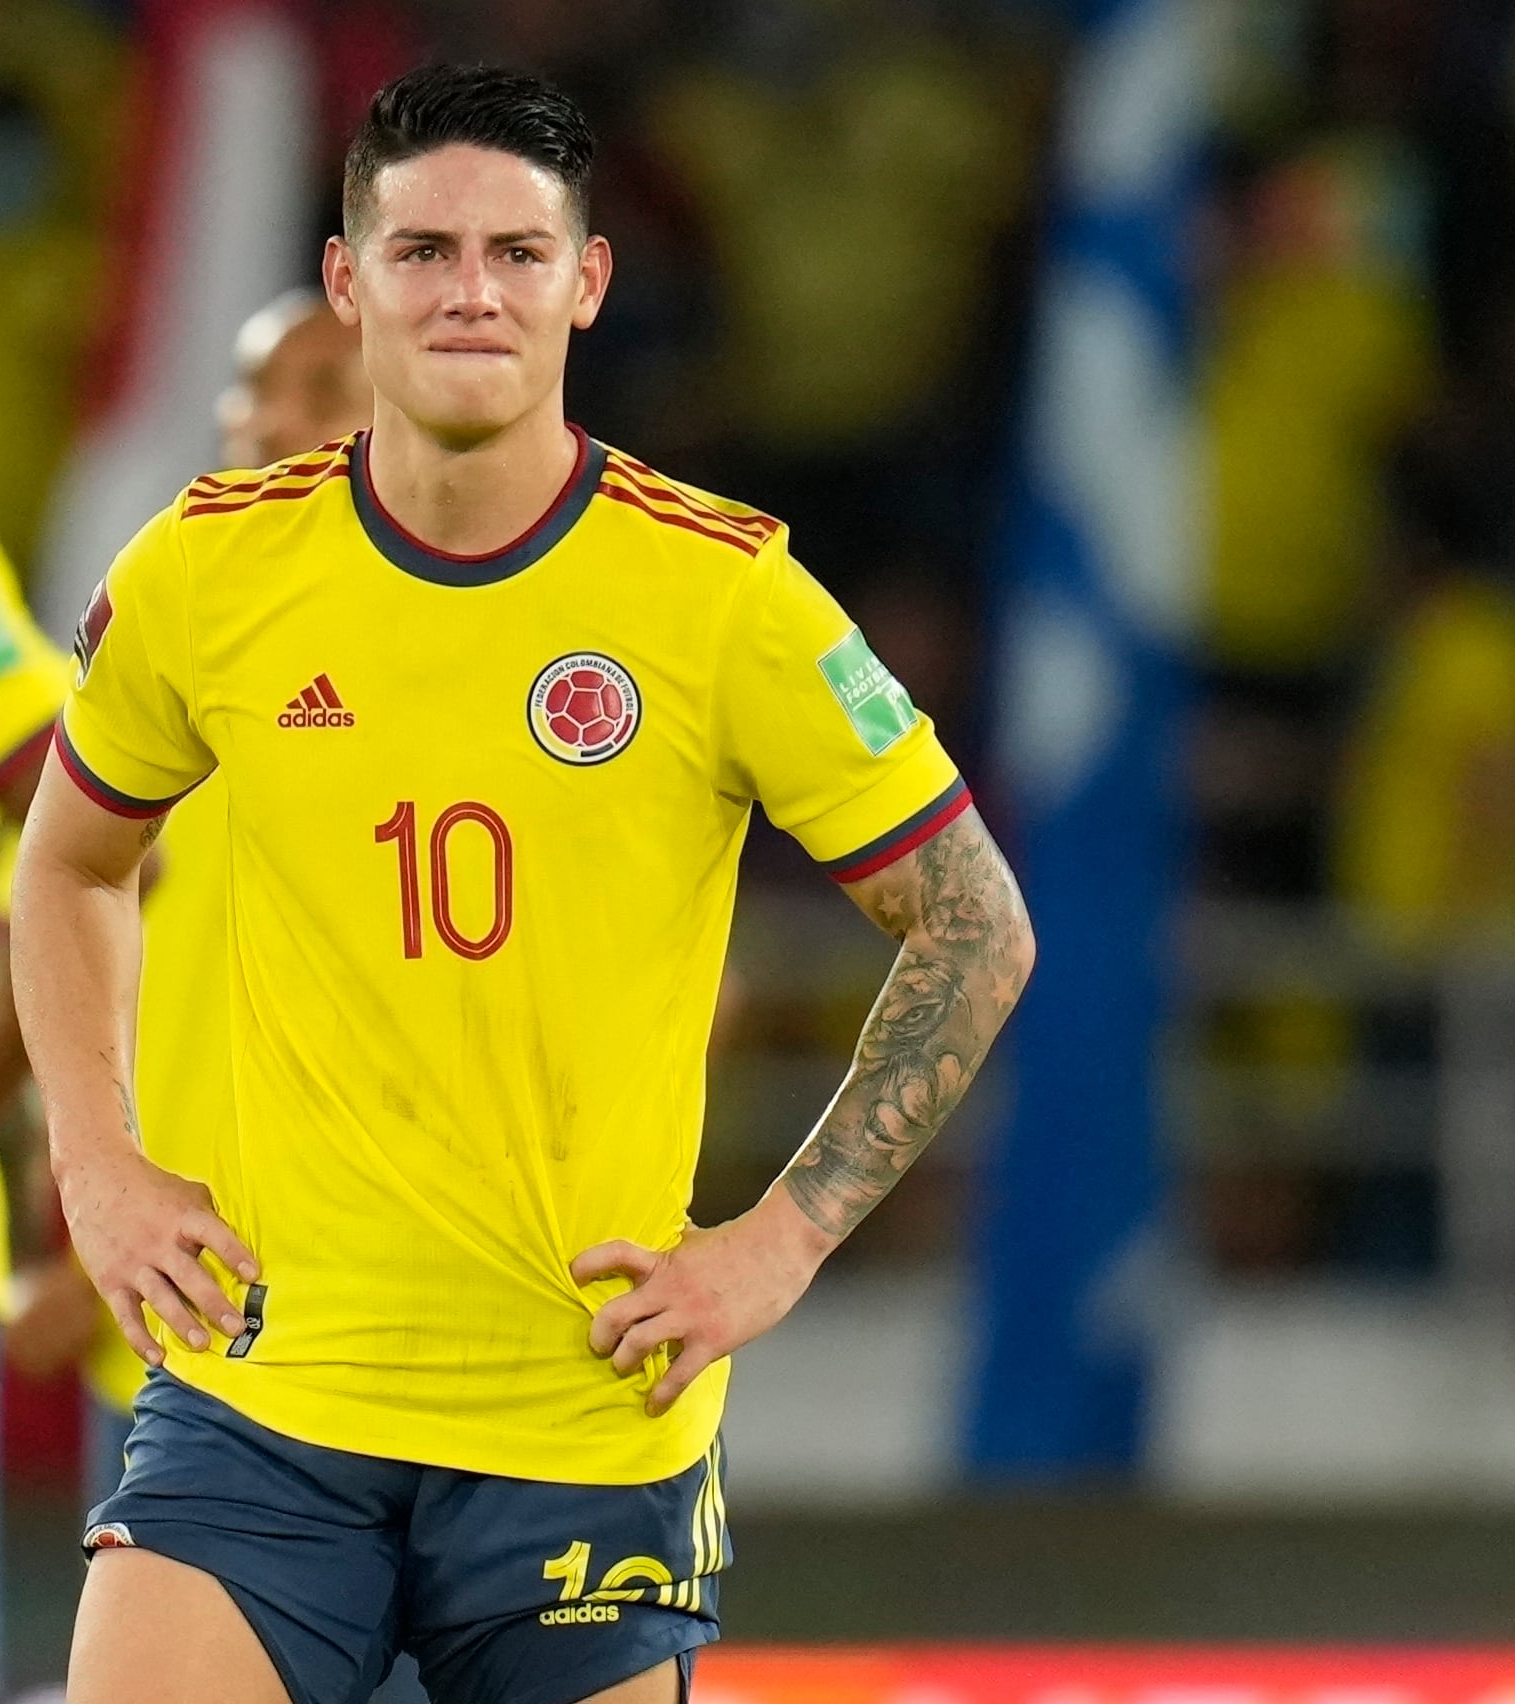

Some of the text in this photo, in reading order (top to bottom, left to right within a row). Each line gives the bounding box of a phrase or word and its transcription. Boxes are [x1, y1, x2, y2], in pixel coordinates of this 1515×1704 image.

[565, 658, 616, 678] COLOMBIANA
[277, 707, 355, 728] adidas
[374, 801, 513, 962] 10
[539, 1603, 620, 1626] adidas
